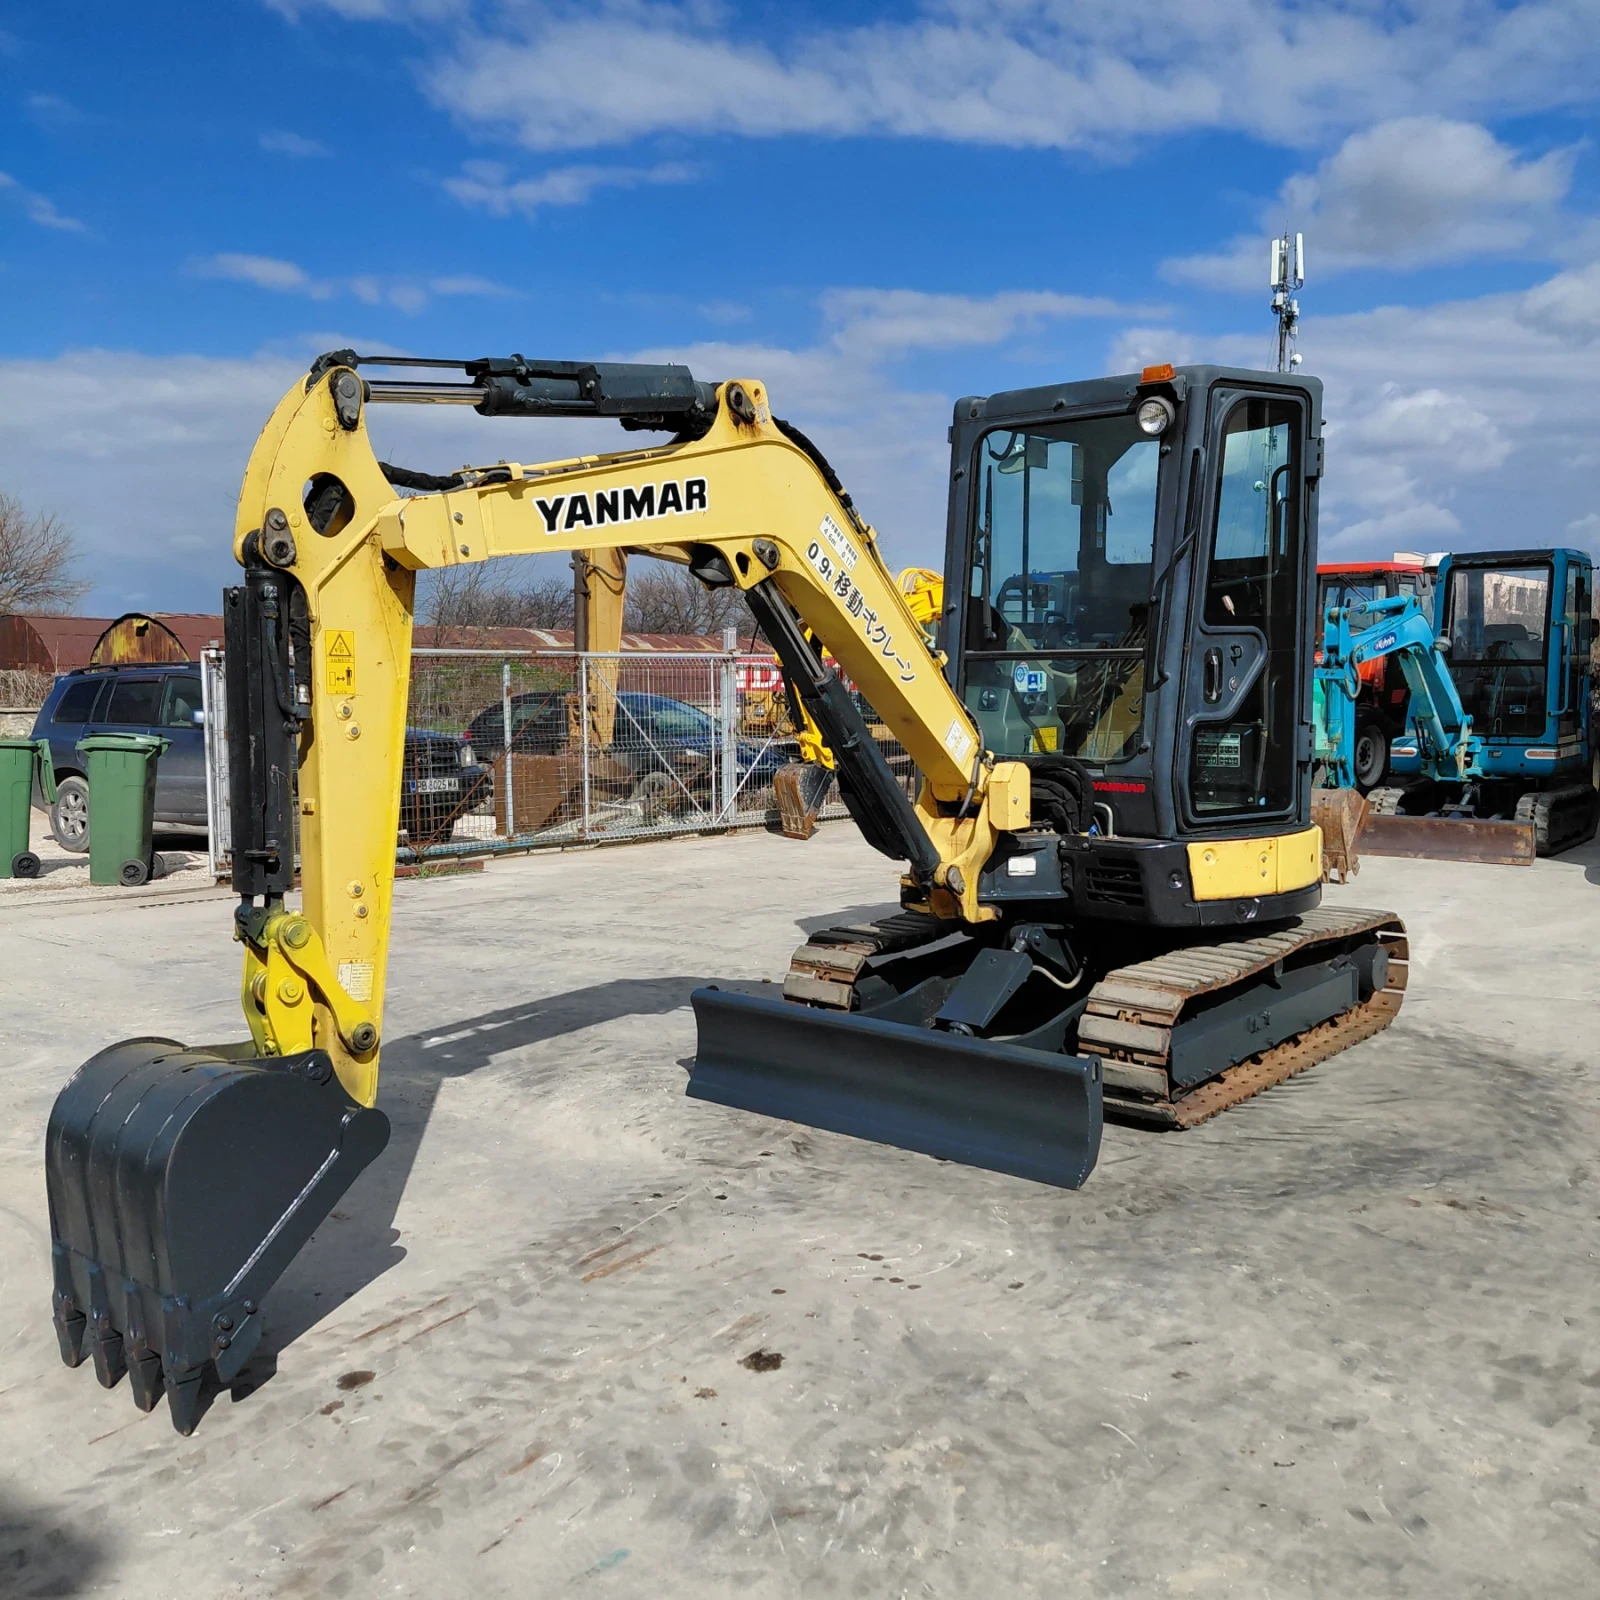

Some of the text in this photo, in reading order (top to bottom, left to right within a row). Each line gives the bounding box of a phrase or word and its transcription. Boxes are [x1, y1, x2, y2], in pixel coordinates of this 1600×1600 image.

[534, 478, 707, 533] YANMAR
[808, 542, 832, 583] 0.9t
[1092, 781, 1146, 793] YANMAR
